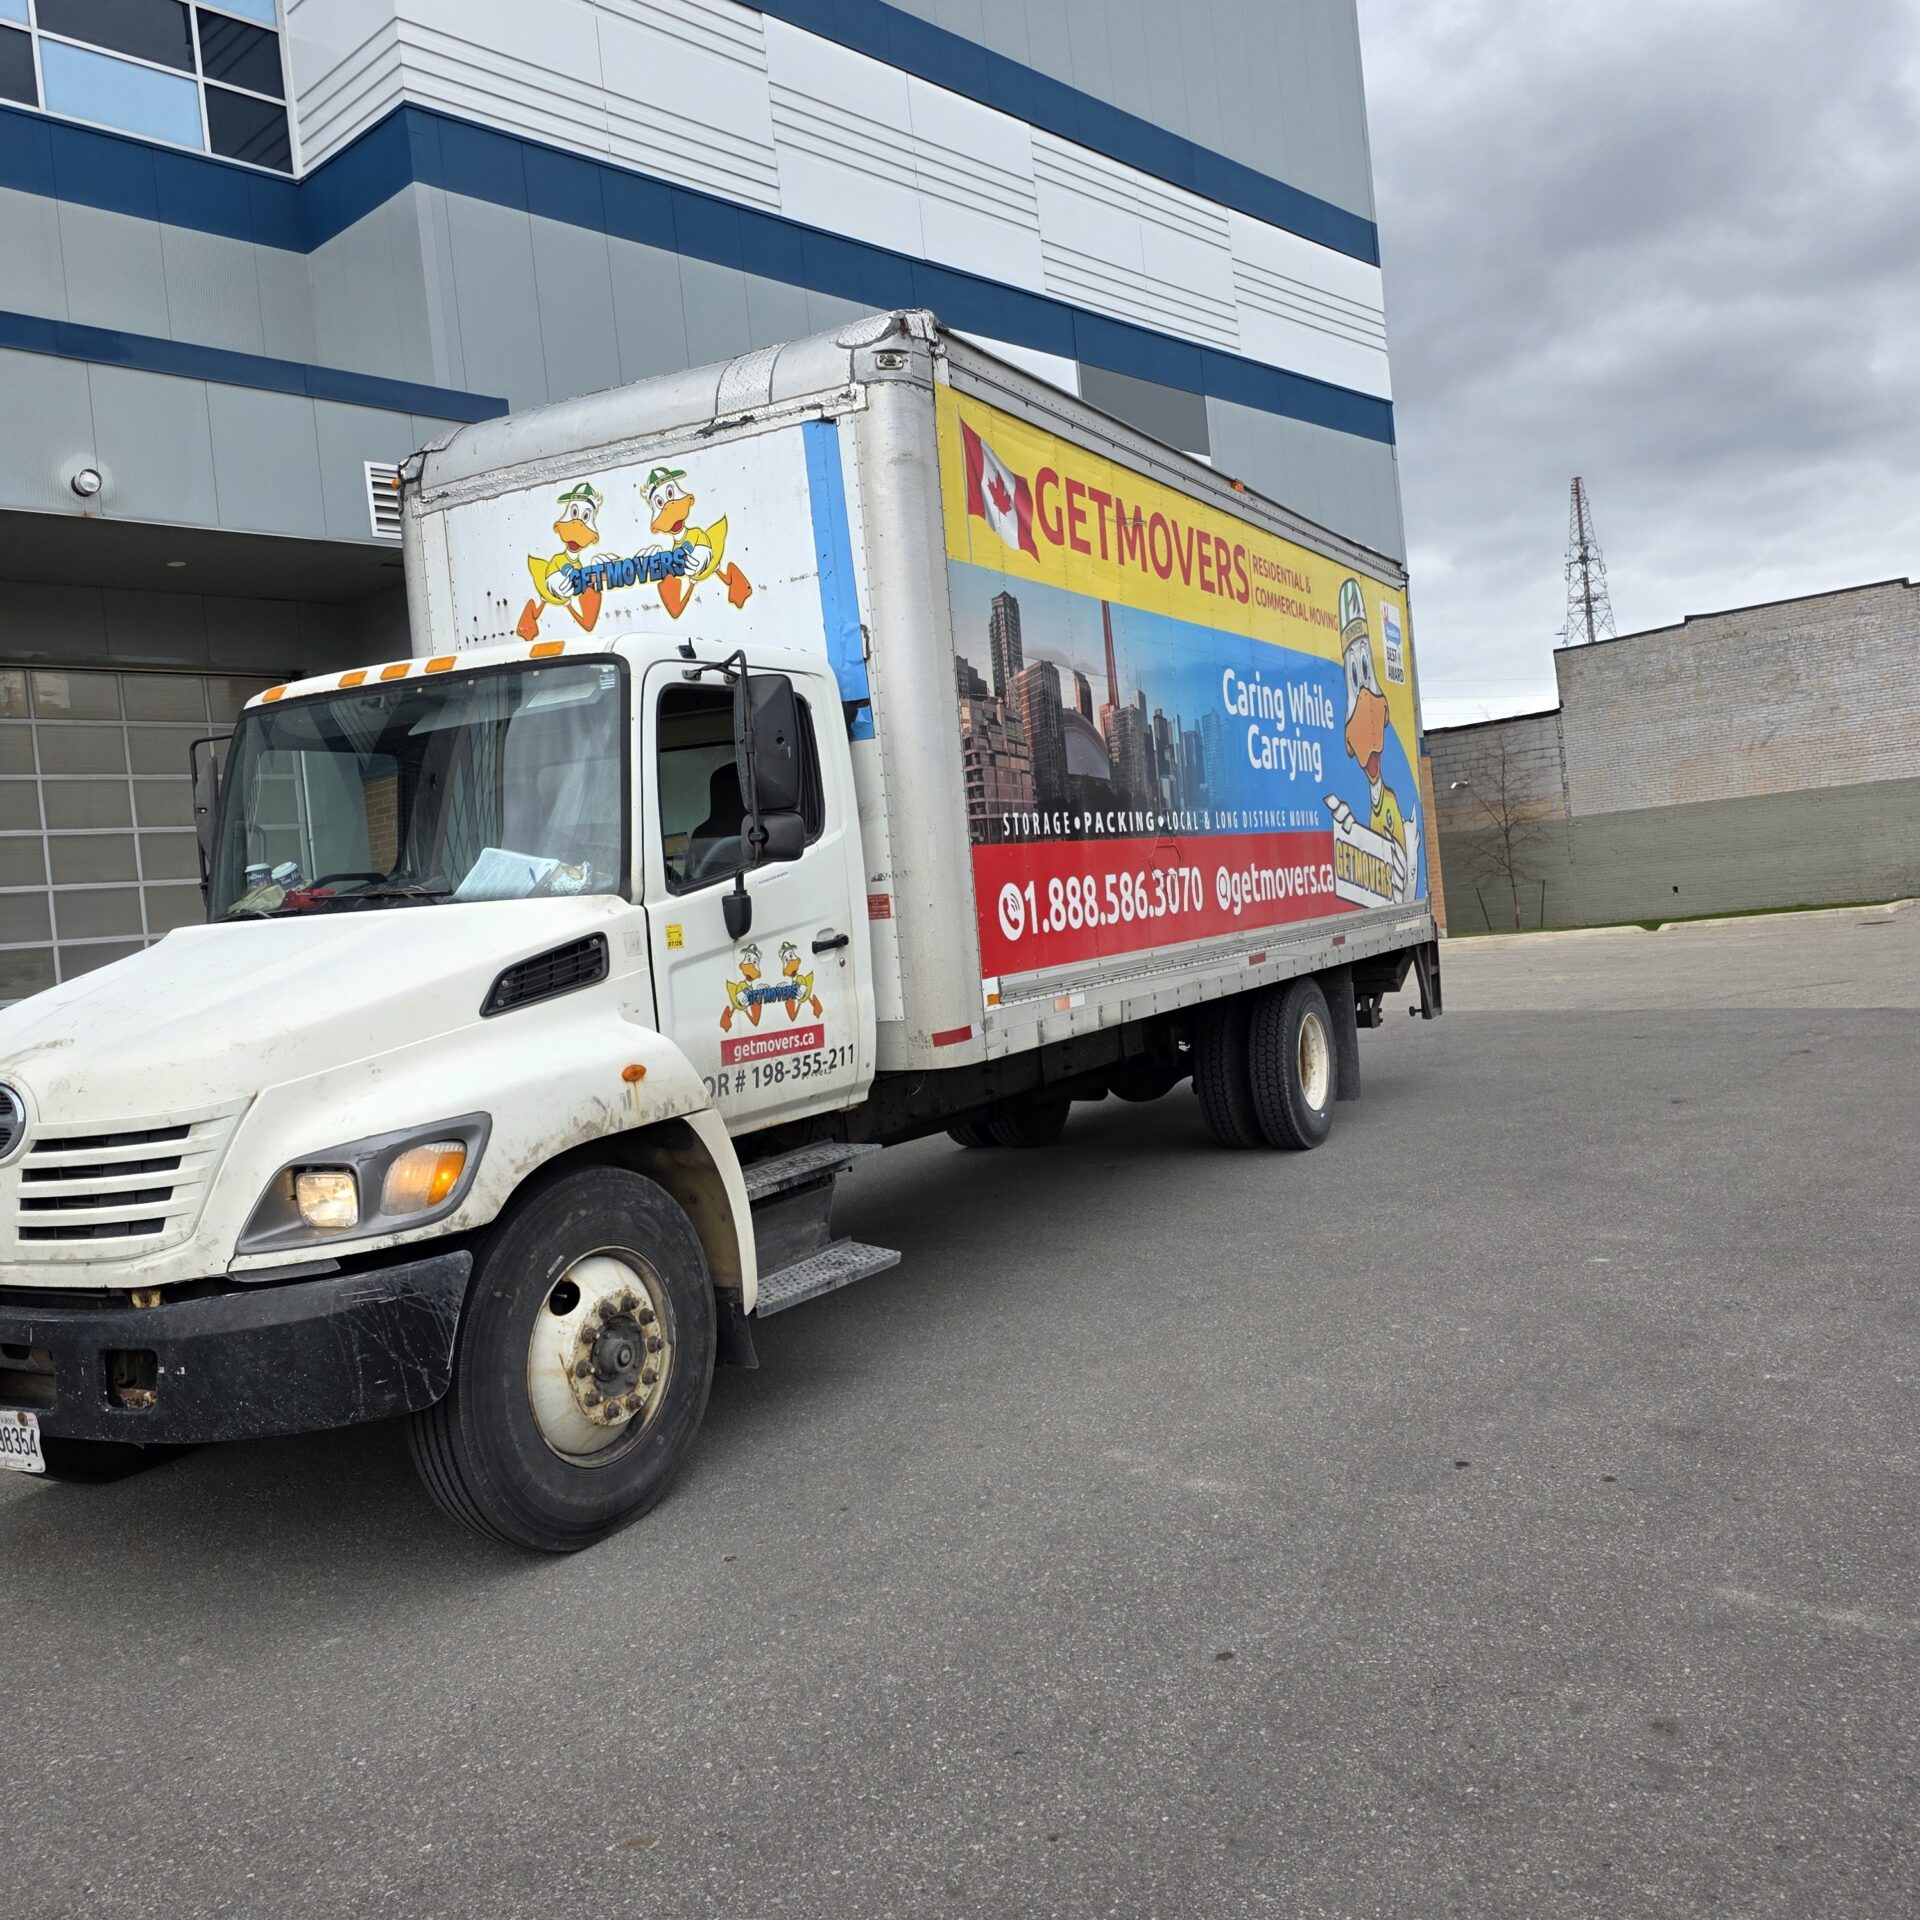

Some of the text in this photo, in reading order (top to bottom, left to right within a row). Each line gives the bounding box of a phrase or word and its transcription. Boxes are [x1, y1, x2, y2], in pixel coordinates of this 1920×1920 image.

[1034, 466, 1250, 605] GETMOVERS
[1252, 554, 1311, 595] RESIDENTIAL &
[1255, 587, 1309, 623] COMMERCIAL
[1309, 606, 1339, 632] MOVING
[1222, 667, 1335, 732] Caring While
[1388, 665, 1405, 684] AWARD
[1247, 723, 1323, 783] Carrying
[1002, 810, 1320, 836] STORAGE PACKING LOCAL & LONG DISTANCE MOVING
[1335, 837, 1393, 902] GETMOVERS
[1023, 866, 1204, 935] 1.888.586.3070
[733, 1031, 815, 1062] getmovers.ca
[734, 1069, 747, 1094] #
[751, 1043, 855, 1089] 198-355-211
